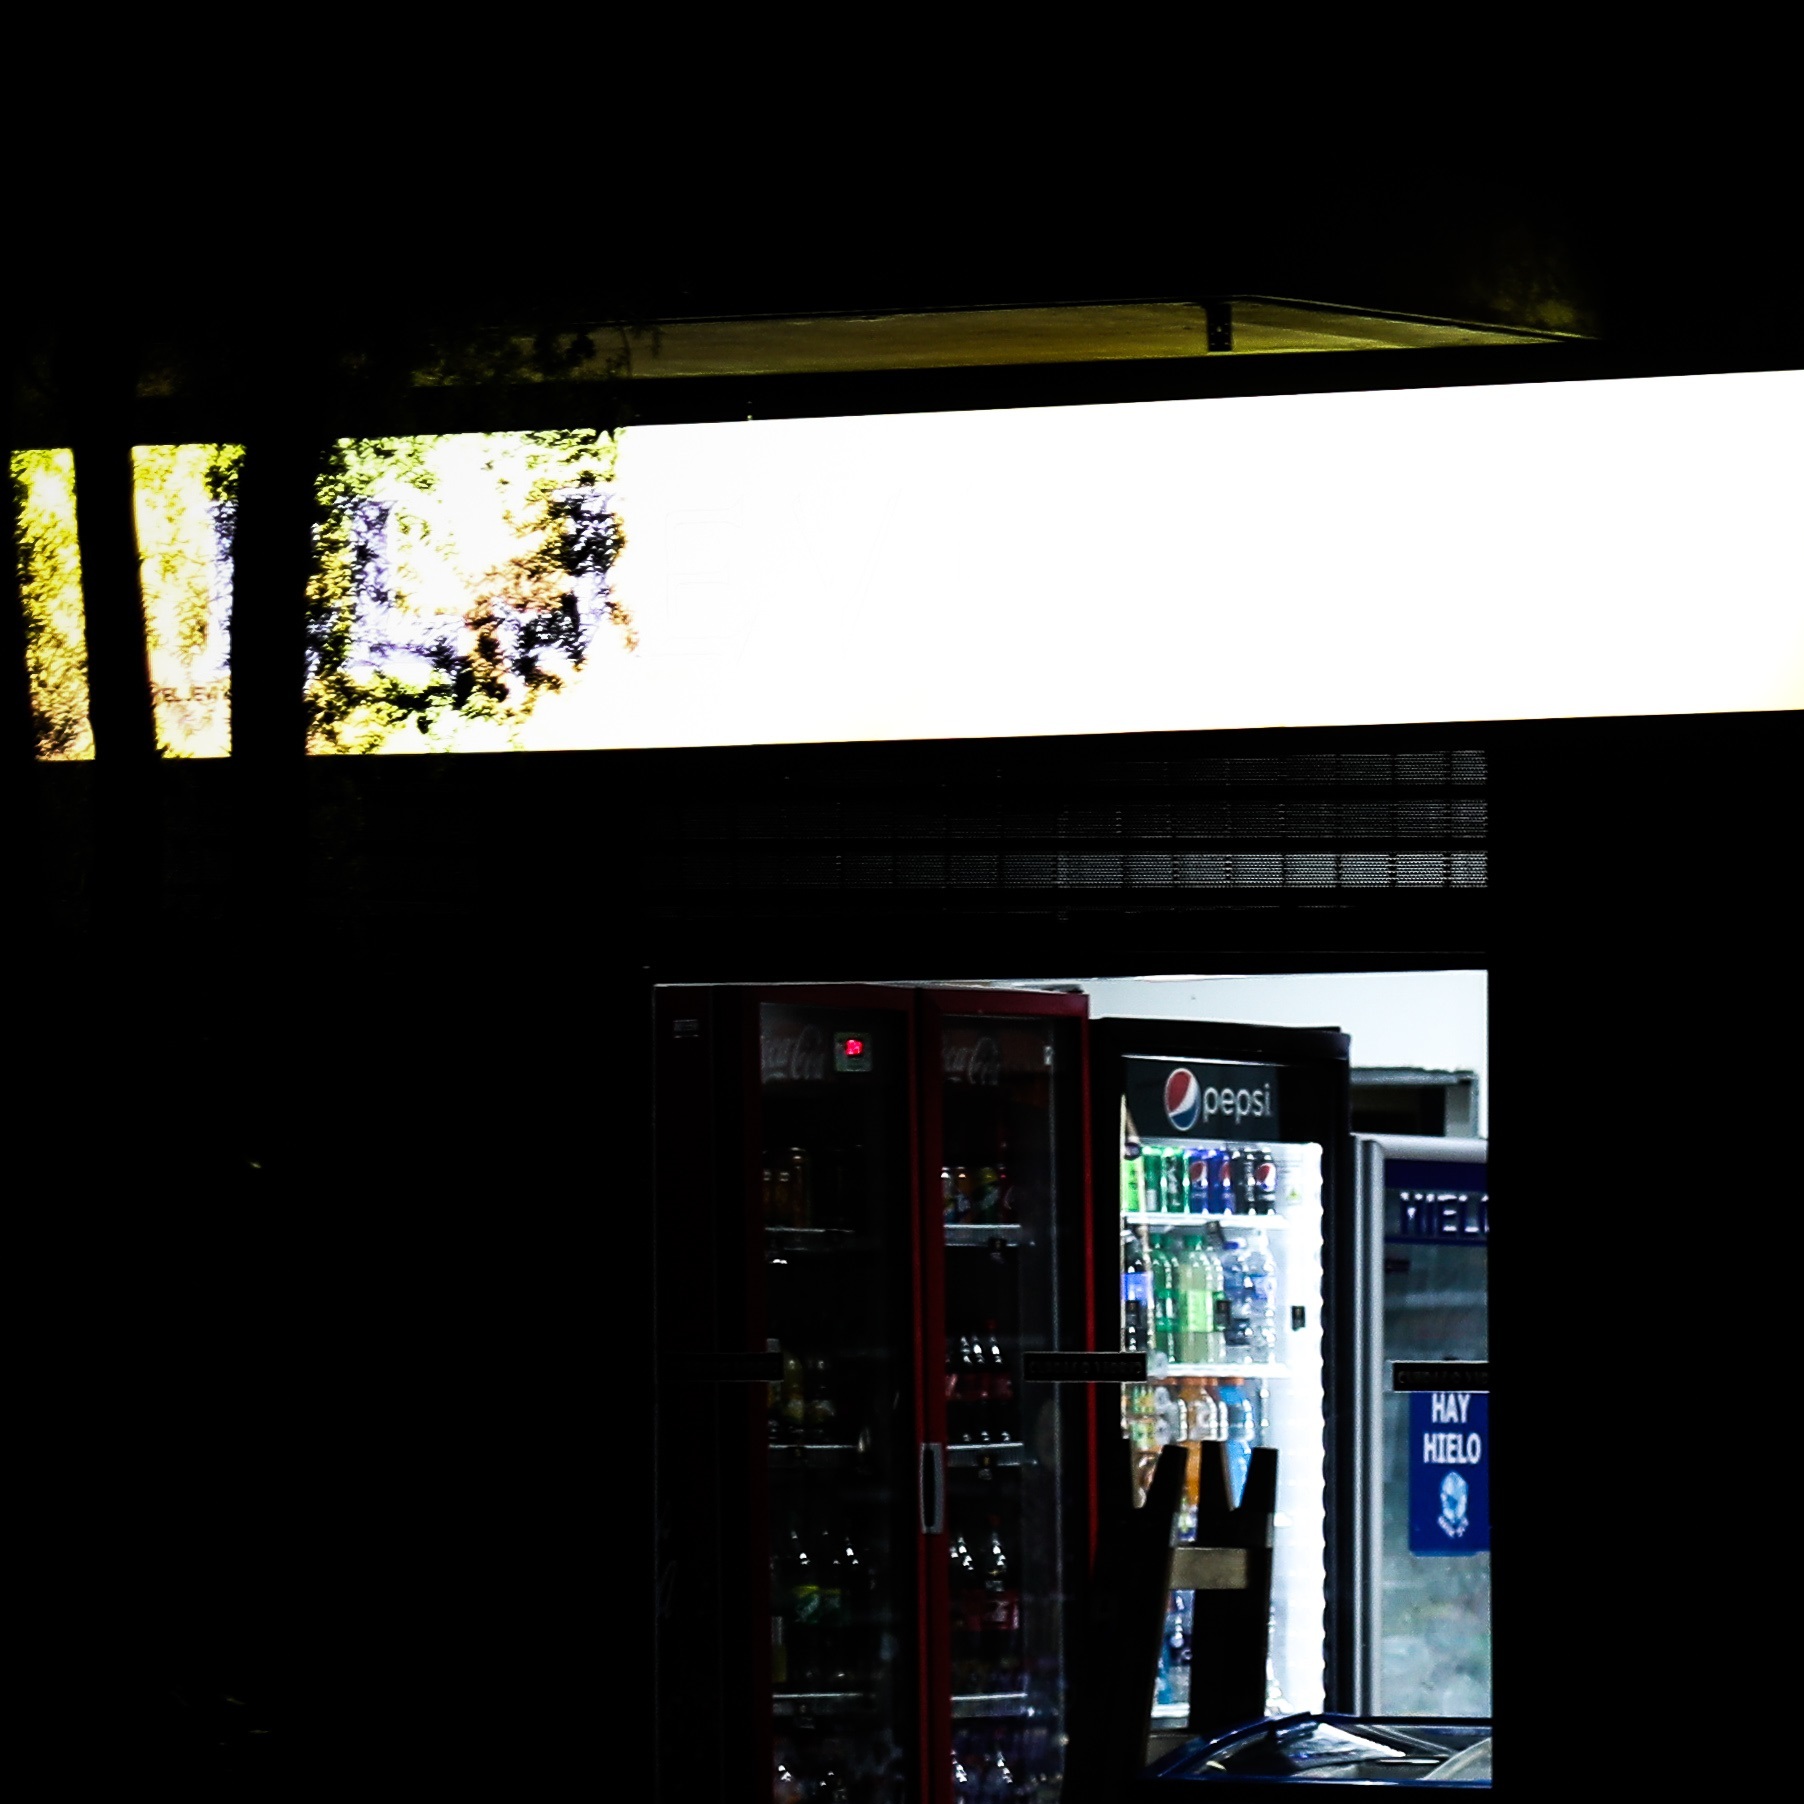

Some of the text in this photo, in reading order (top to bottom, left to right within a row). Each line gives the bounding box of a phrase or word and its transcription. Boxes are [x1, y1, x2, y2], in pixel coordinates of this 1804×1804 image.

[1202, 1082, 1272, 1125] pepsi
[1431, 1393, 1471, 1424] HAY
[1422, 1432, 1483, 1465] HIELO
